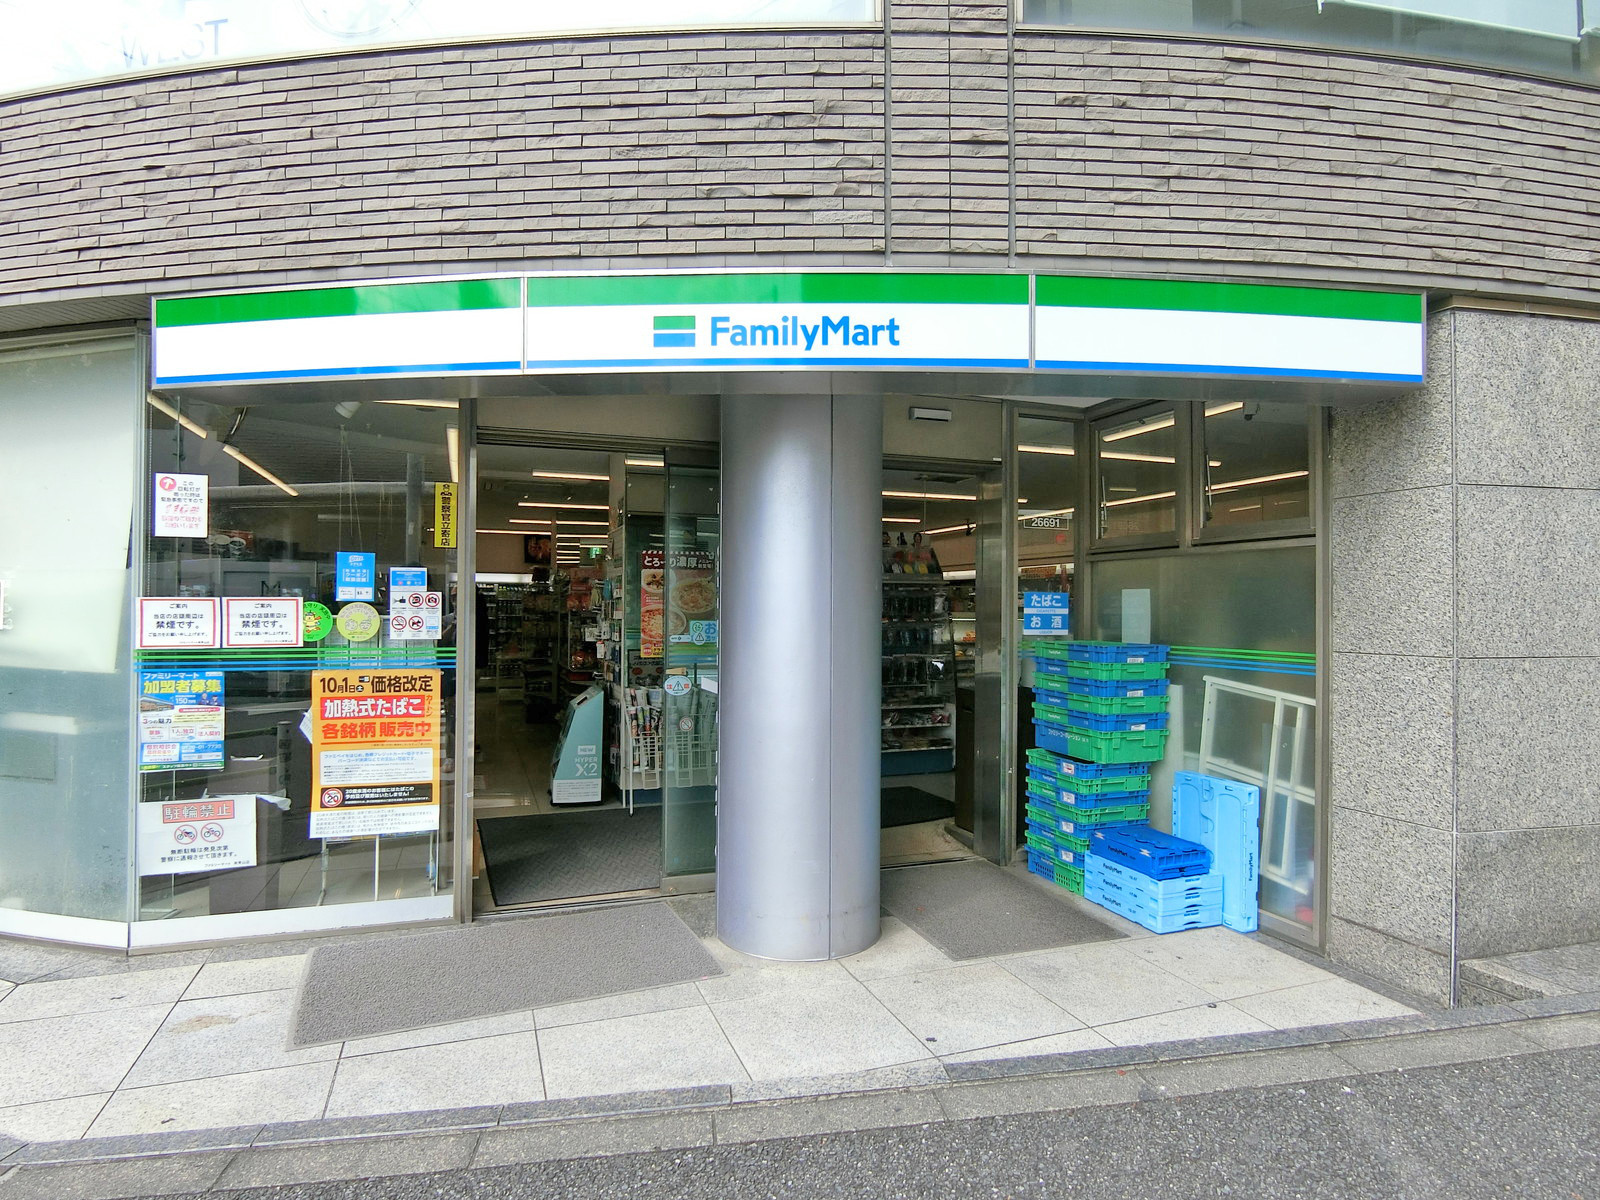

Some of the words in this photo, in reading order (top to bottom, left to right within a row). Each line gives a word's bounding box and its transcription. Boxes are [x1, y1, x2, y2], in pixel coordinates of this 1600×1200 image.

[711, 315, 900, 351] FamilyMart
[1031, 517, 1060, 528] 26691
[1030, 594, 1062, 607] たばこ
[156, 620, 200, 630] 禁煙です。
[241, 619, 283, 629] 禁煙です。
[143, 672, 200, 680] ファミリーマート
[143, 679, 221, 694] 加盟者募集
[371, 675, 433, 694] 価格改定
[324, 697, 422, 718] 加熱式たばこ
[575, 762, 598, 777] X2
[164, 803, 232, 820] 駐輪禁止
[1107, 845, 1128, 857] FamilyMart
[1102, 863, 1123, 875] FamilyMart
[1102, 879, 1123, 891] FamilyMart
[1102, 895, 1122, 908] FamilyMart
